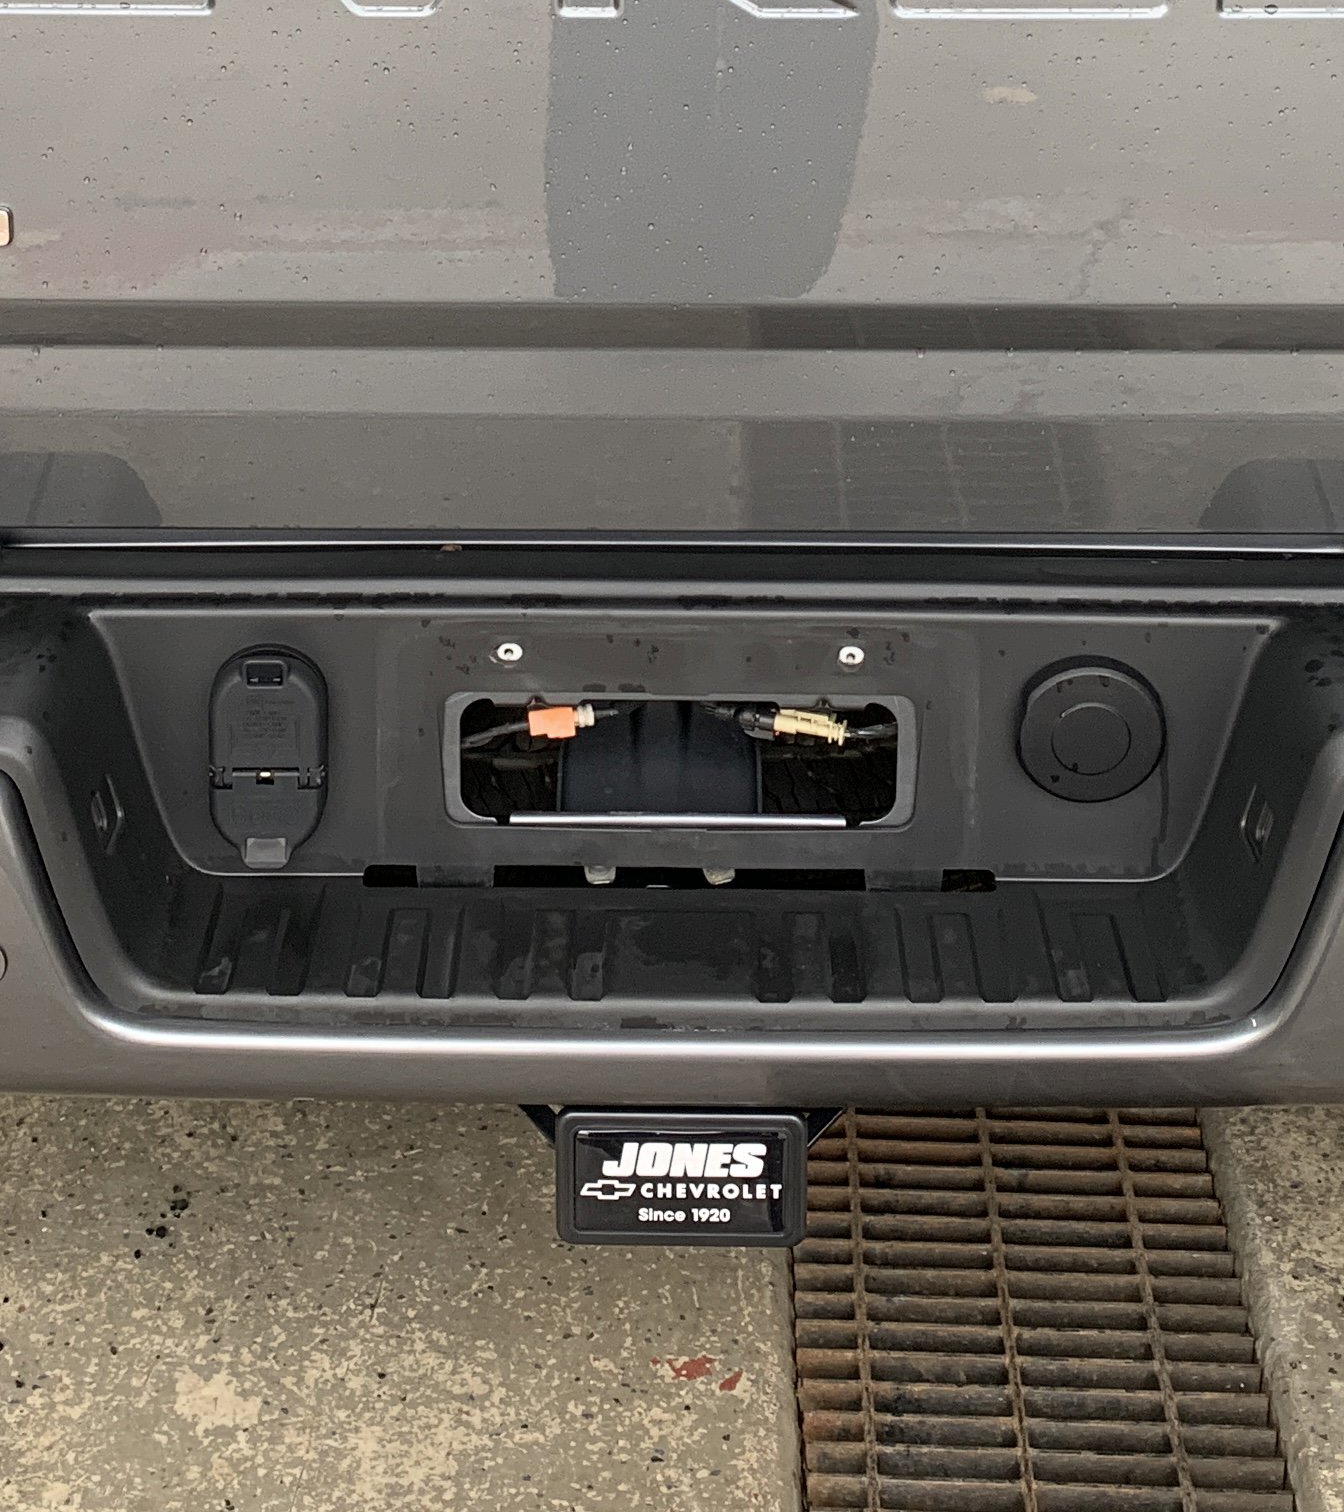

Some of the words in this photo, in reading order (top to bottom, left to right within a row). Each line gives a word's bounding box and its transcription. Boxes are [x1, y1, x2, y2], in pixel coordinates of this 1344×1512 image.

[602, 1141, 768, 1178] JONES
[640, 1182, 783, 1201] CHEVROLET
[637, 1207, 687, 1223] Since
[691, 1207, 731, 1223] 1920
